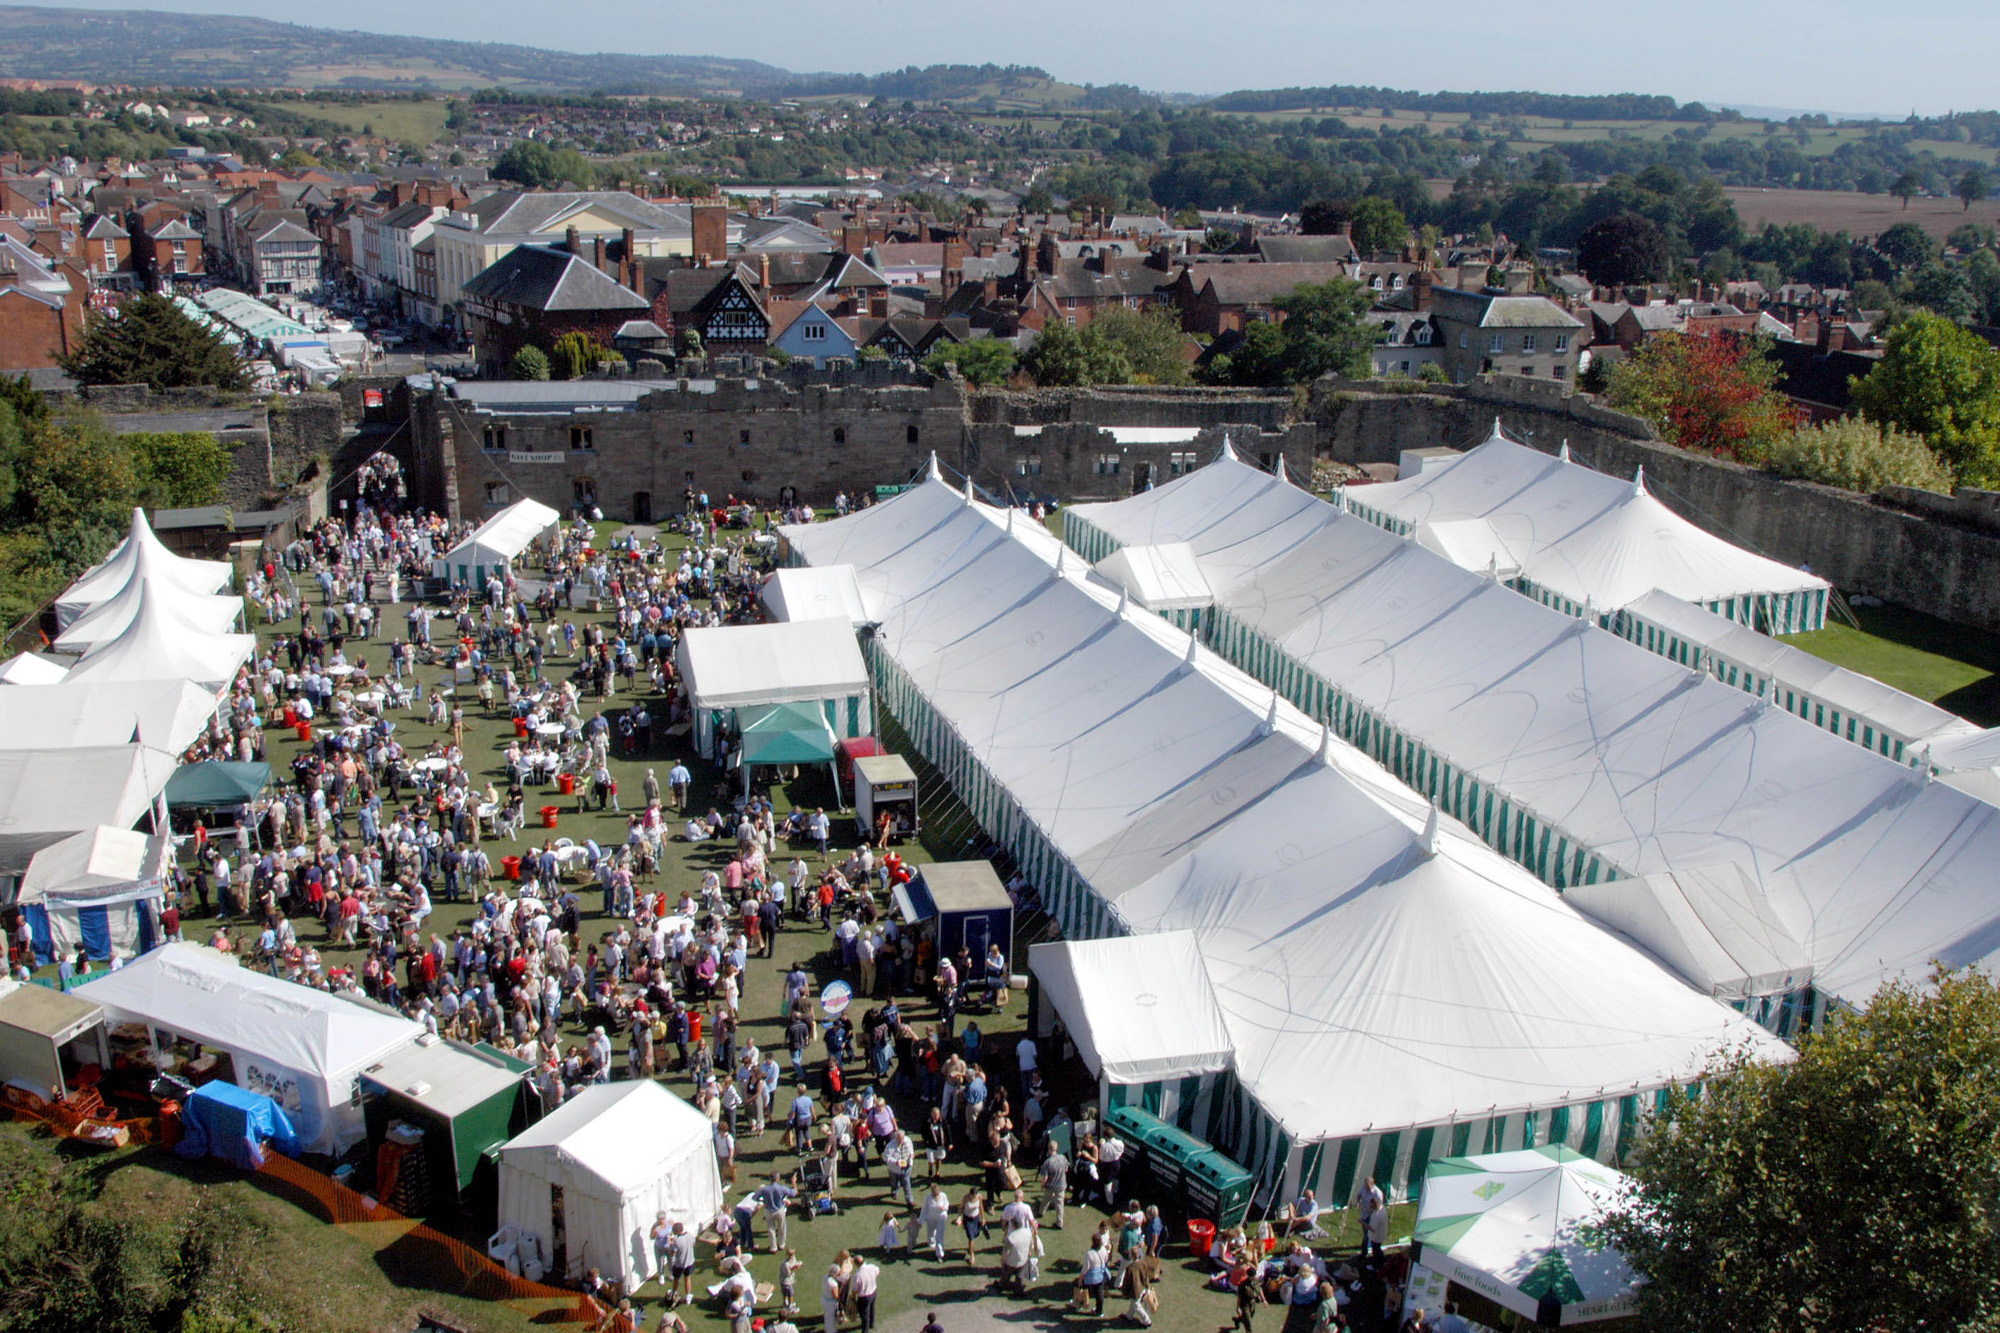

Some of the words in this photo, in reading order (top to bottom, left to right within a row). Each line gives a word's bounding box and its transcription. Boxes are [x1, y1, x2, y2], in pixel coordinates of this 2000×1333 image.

[1454, 1266, 1473, 1281] fine
[1475, 1276, 1502, 1297] foods
[1578, 1304, 1608, 1317] HEART
